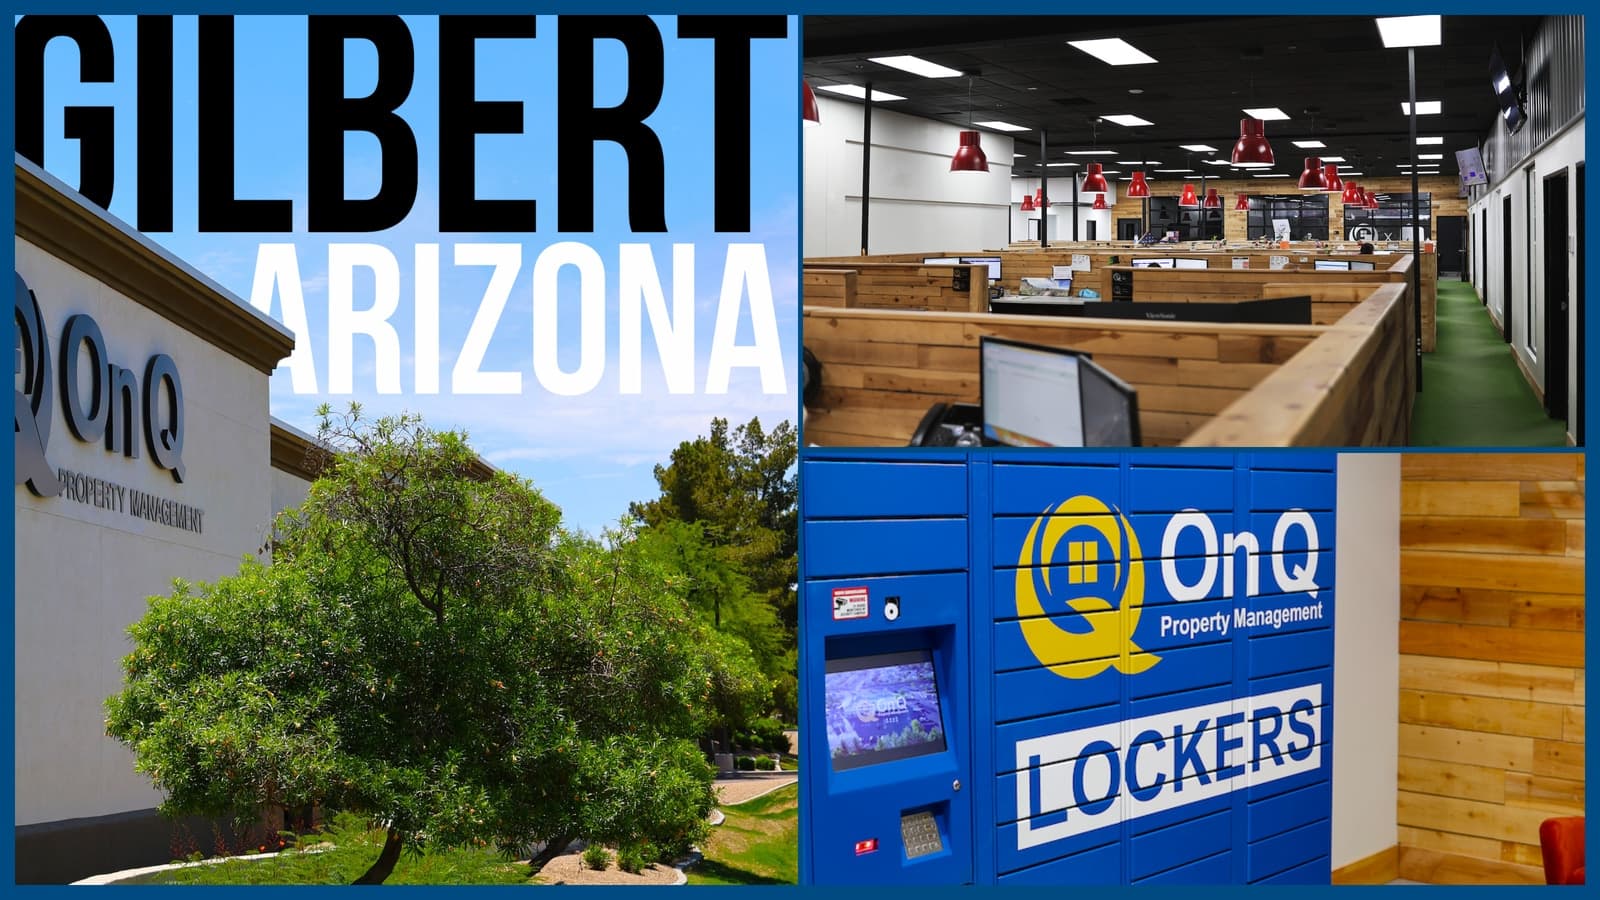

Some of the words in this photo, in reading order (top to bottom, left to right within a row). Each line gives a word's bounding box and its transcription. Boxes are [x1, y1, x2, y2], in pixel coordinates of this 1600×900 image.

[59, 313, 139, 459] On
[142, 353, 187, 484] Q
[57, 467, 127, 513] PROPERTY
[129, 488, 205, 534] MANAGEMENT
[1161, 508, 1260, 602] On
[1271, 508, 1319, 599] Q
[1160, 611, 1231, 640] Property
[1233, 601, 1323, 629] Management
[1028, 699, 1316, 831] LOCKERS
